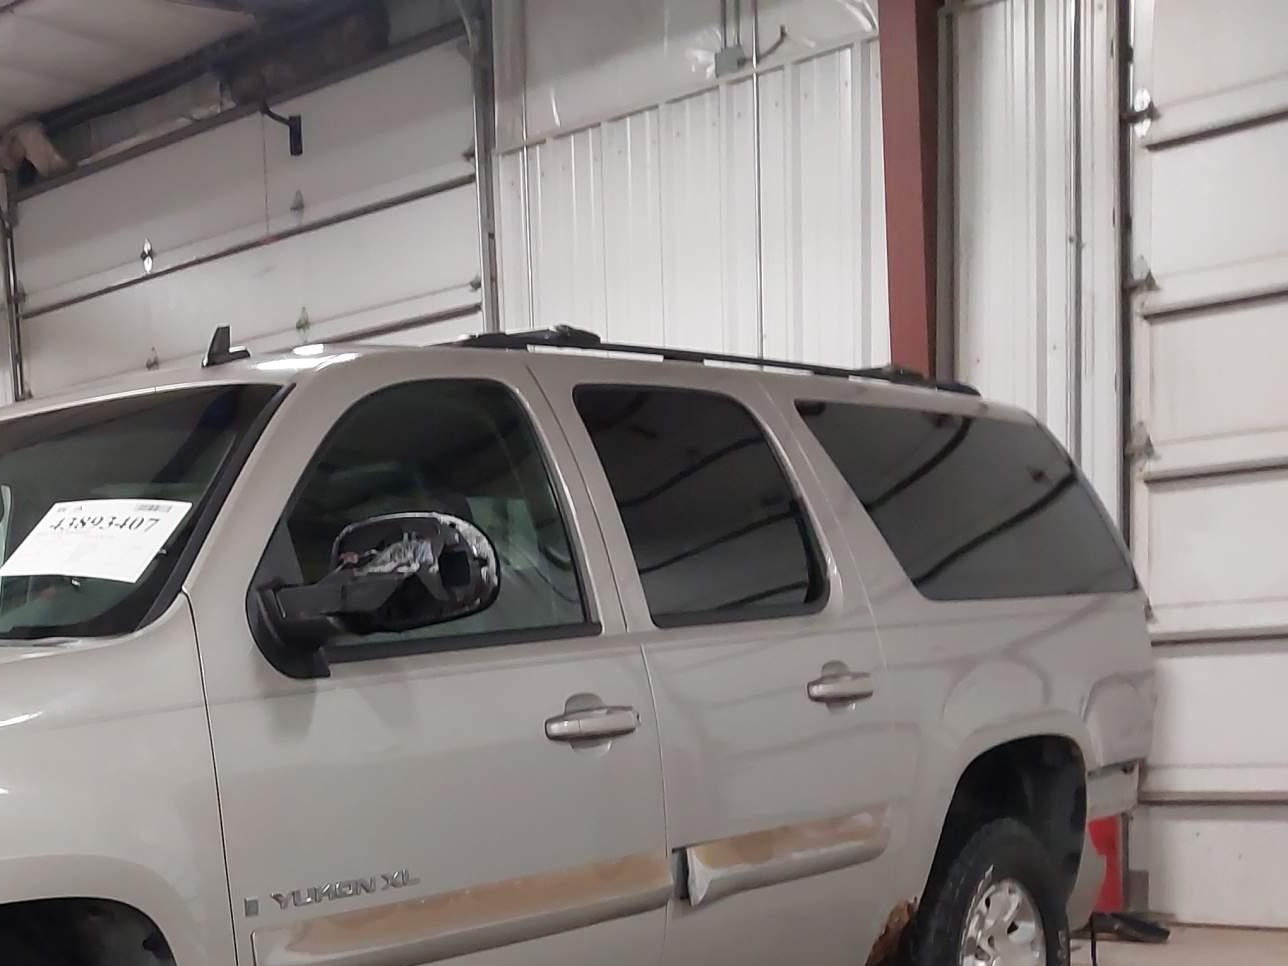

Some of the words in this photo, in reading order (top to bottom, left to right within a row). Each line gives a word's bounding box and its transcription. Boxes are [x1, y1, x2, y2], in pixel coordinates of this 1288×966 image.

[49, 516, 160, 532] 43893407
[270, 877, 376, 910] YUKON
[380, 868, 420, 891] XL
